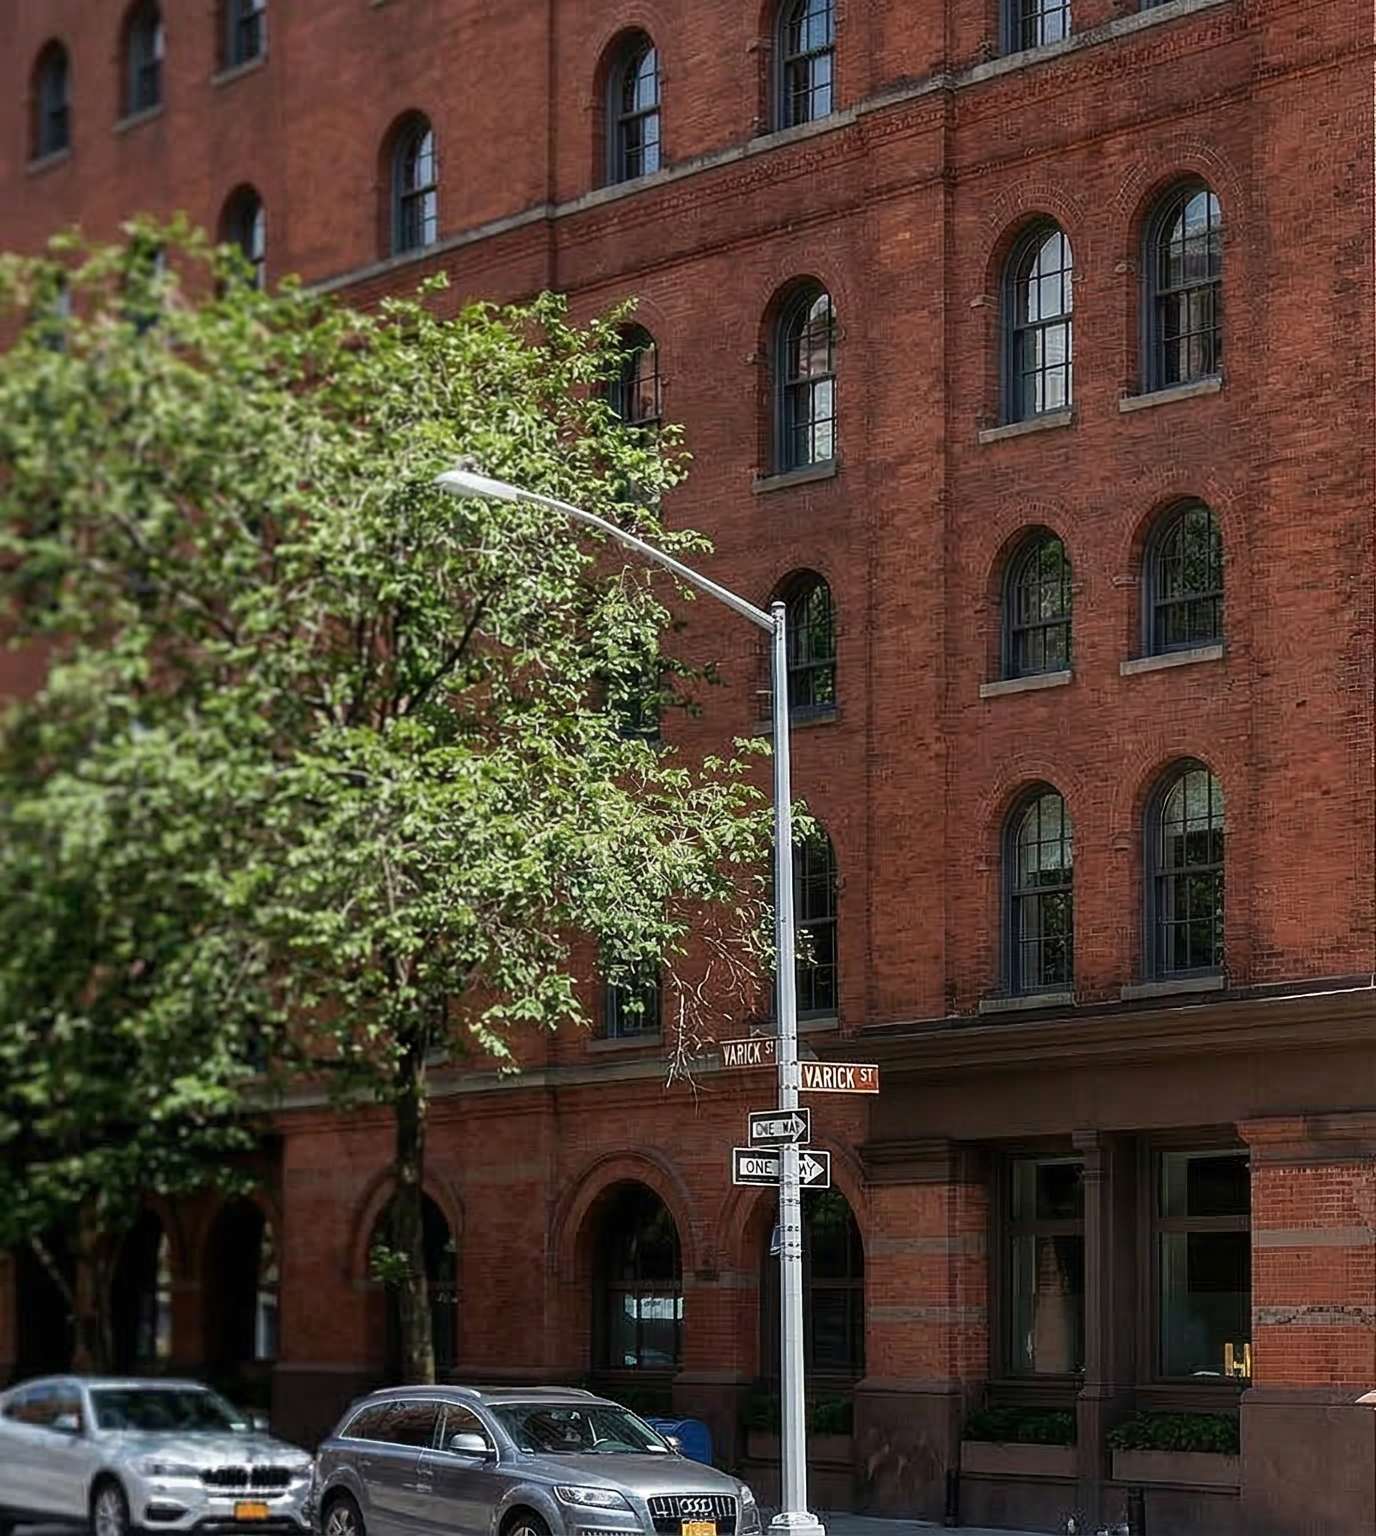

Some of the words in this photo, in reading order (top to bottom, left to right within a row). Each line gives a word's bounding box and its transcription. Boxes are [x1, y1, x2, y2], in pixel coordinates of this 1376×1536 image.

[723, 1042, 762, 1066] VARICK
[803, 1065, 856, 1089] VARICK
[860, 1067, 874, 1082] ST
[755, 1121, 775, 1136] ONE
[746, 1160, 773, 1174] ONE
[799, 1162, 816, 1176] AY
